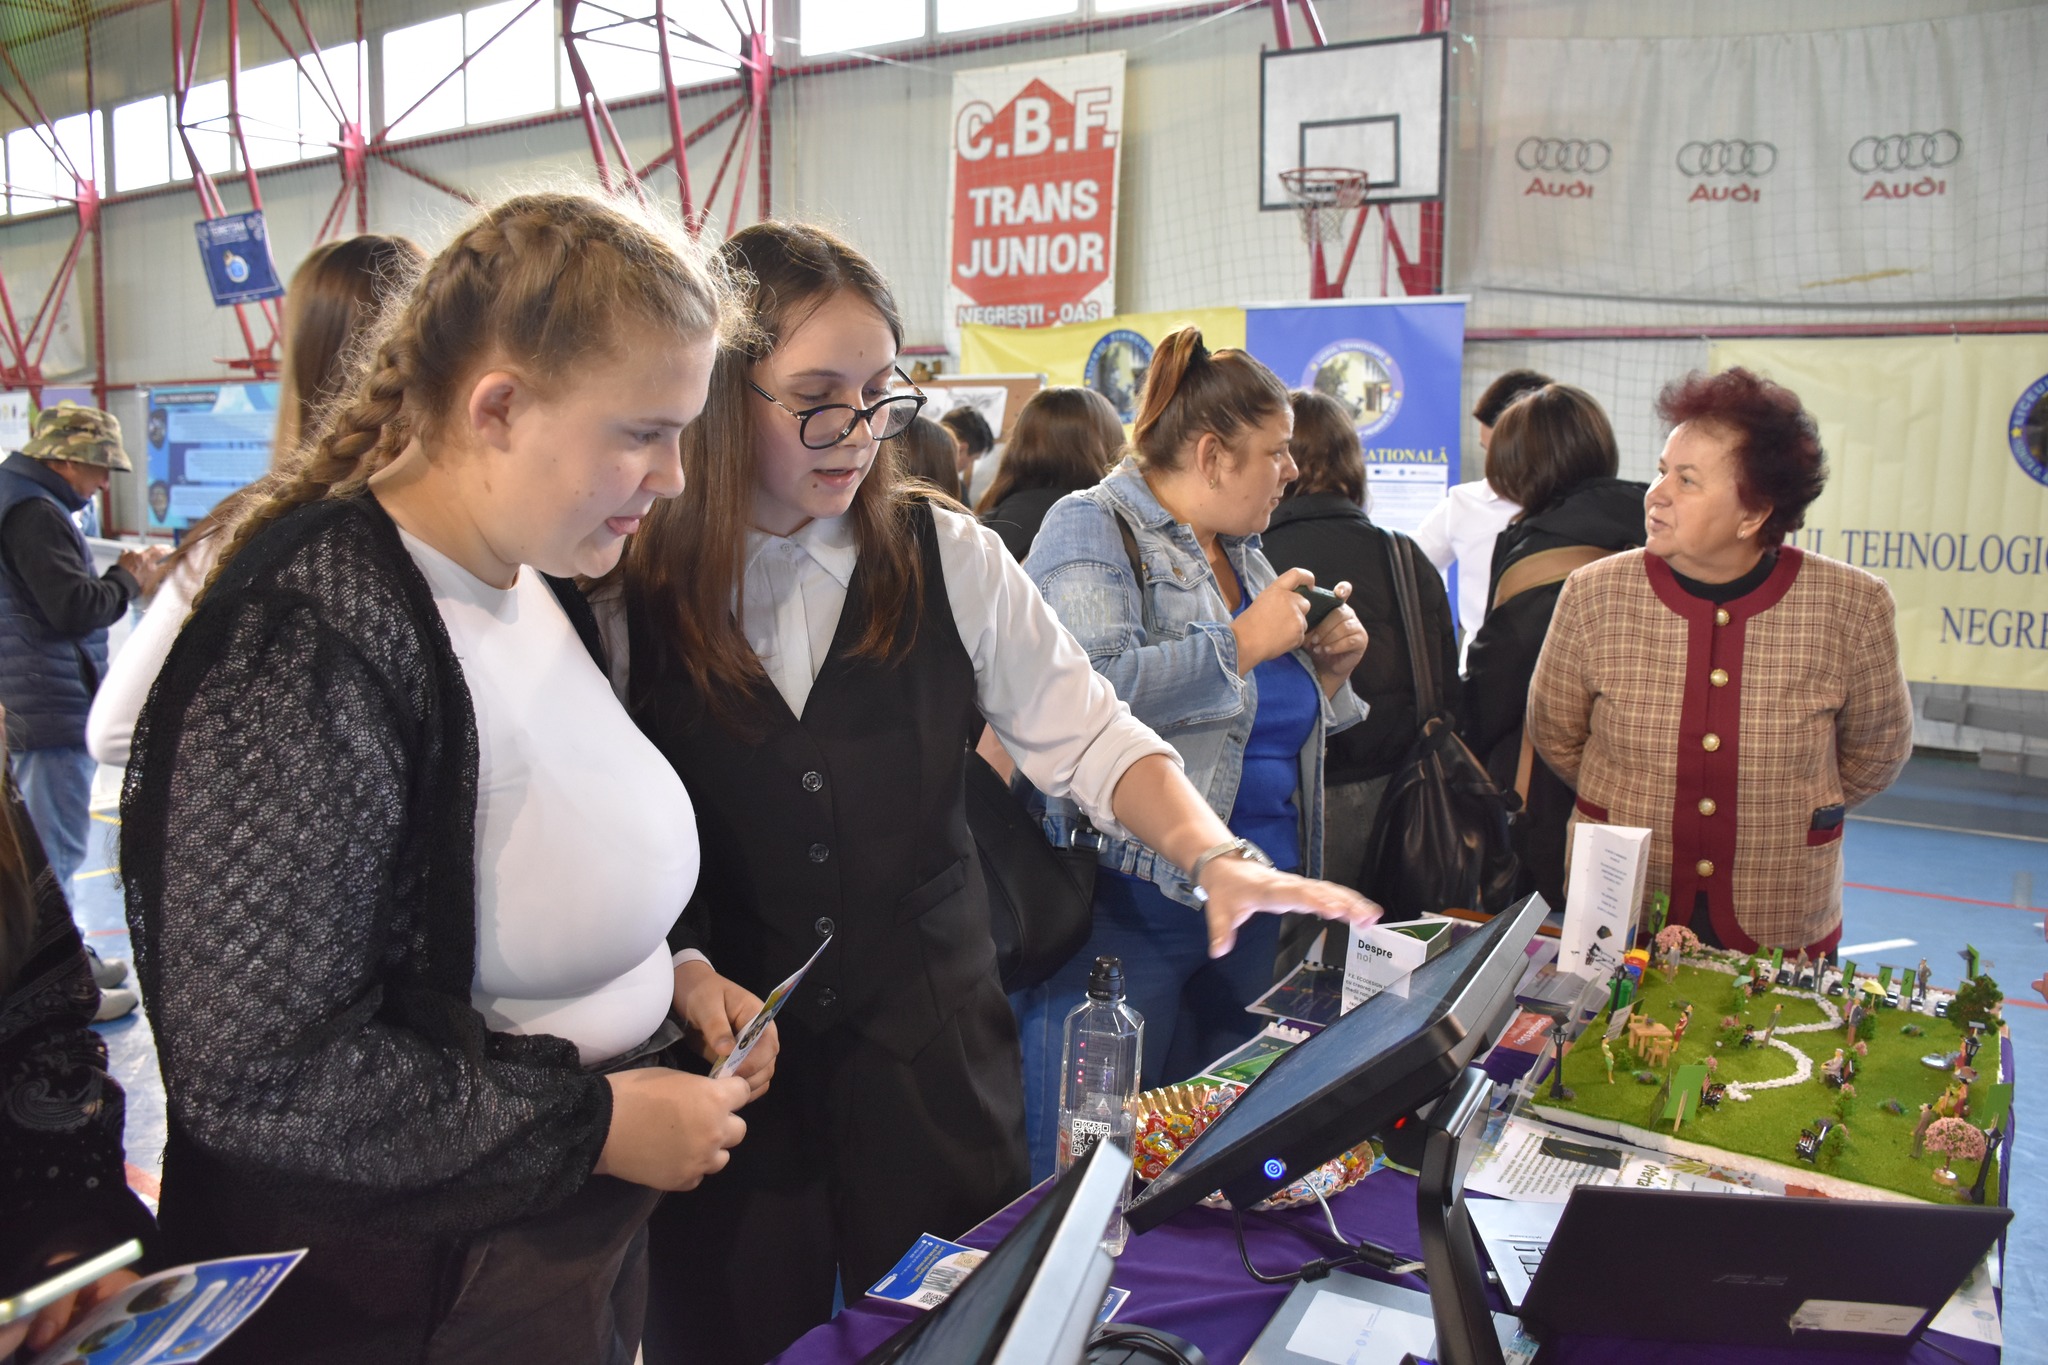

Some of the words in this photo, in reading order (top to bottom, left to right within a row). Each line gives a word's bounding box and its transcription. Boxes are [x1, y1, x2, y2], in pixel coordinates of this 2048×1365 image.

[956, 86, 1119, 161] C.B.F.
[968, 179, 1100, 227] TRANS
[957, 232, 1105, 279] JUNIOR
[1363, 446, 1448, 464] AȚIONALĂ
[1841, 530, 2048, 575] TEHNOLOGI
[1357, 939, 1393, 959] Despre
[1357, 952, 1372, 963] noi
[1636, 1164, 1661, 1187] Oferta
